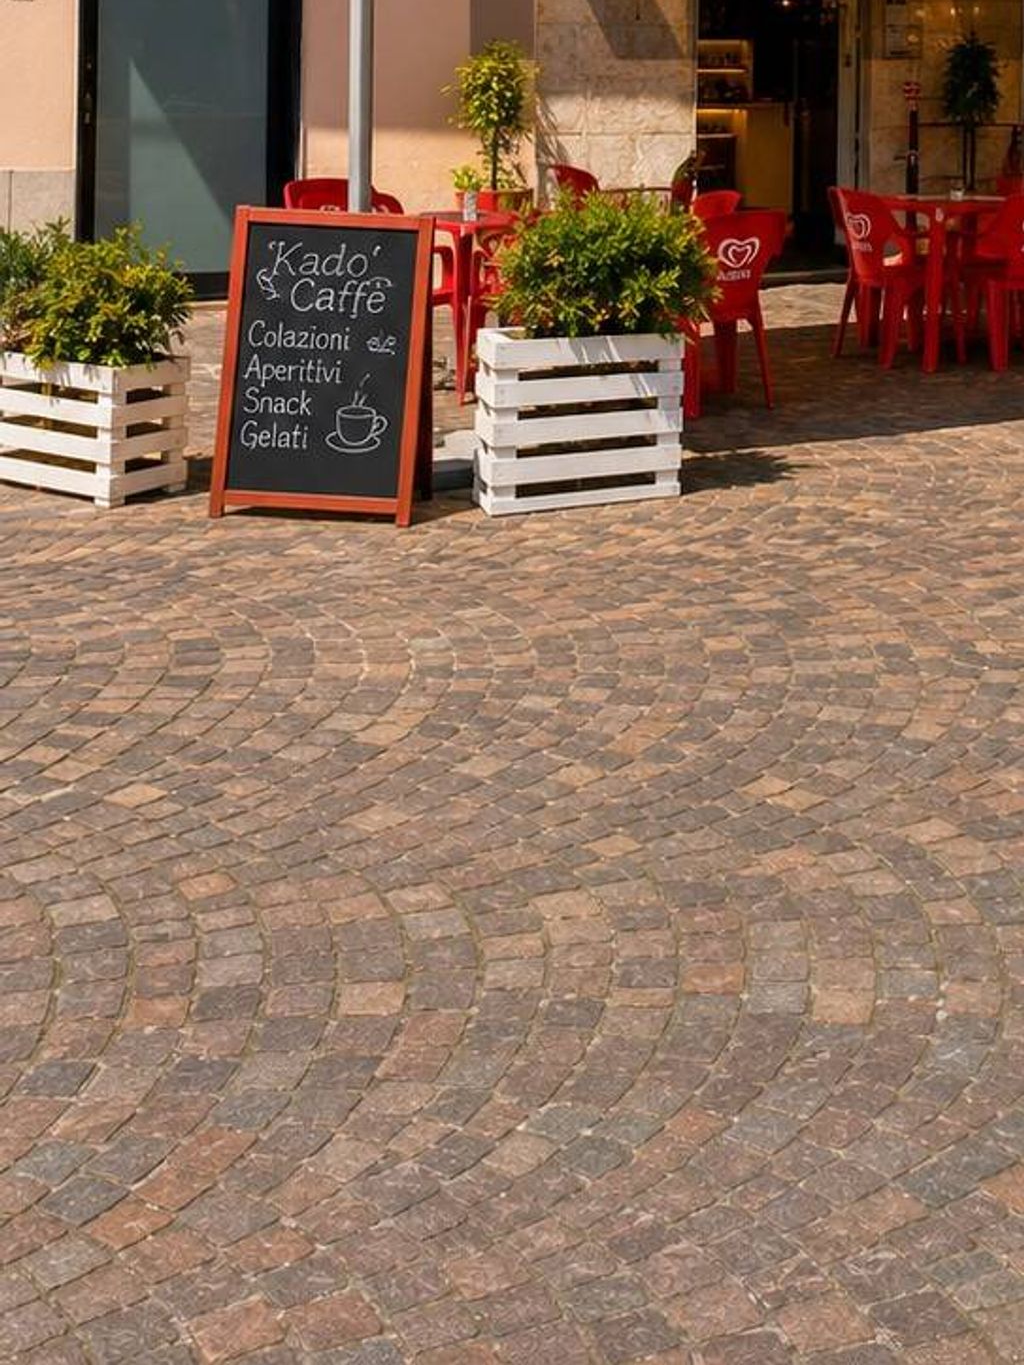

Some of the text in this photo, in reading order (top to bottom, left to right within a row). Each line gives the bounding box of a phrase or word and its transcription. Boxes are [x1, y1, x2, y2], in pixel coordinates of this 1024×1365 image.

[249, 320, 350, 351] Colazioni
[243, 353, 342, 387] Aperitivi
[243, 386, 312, 416] Snack
[240, 420, 308, 450] Gelati
